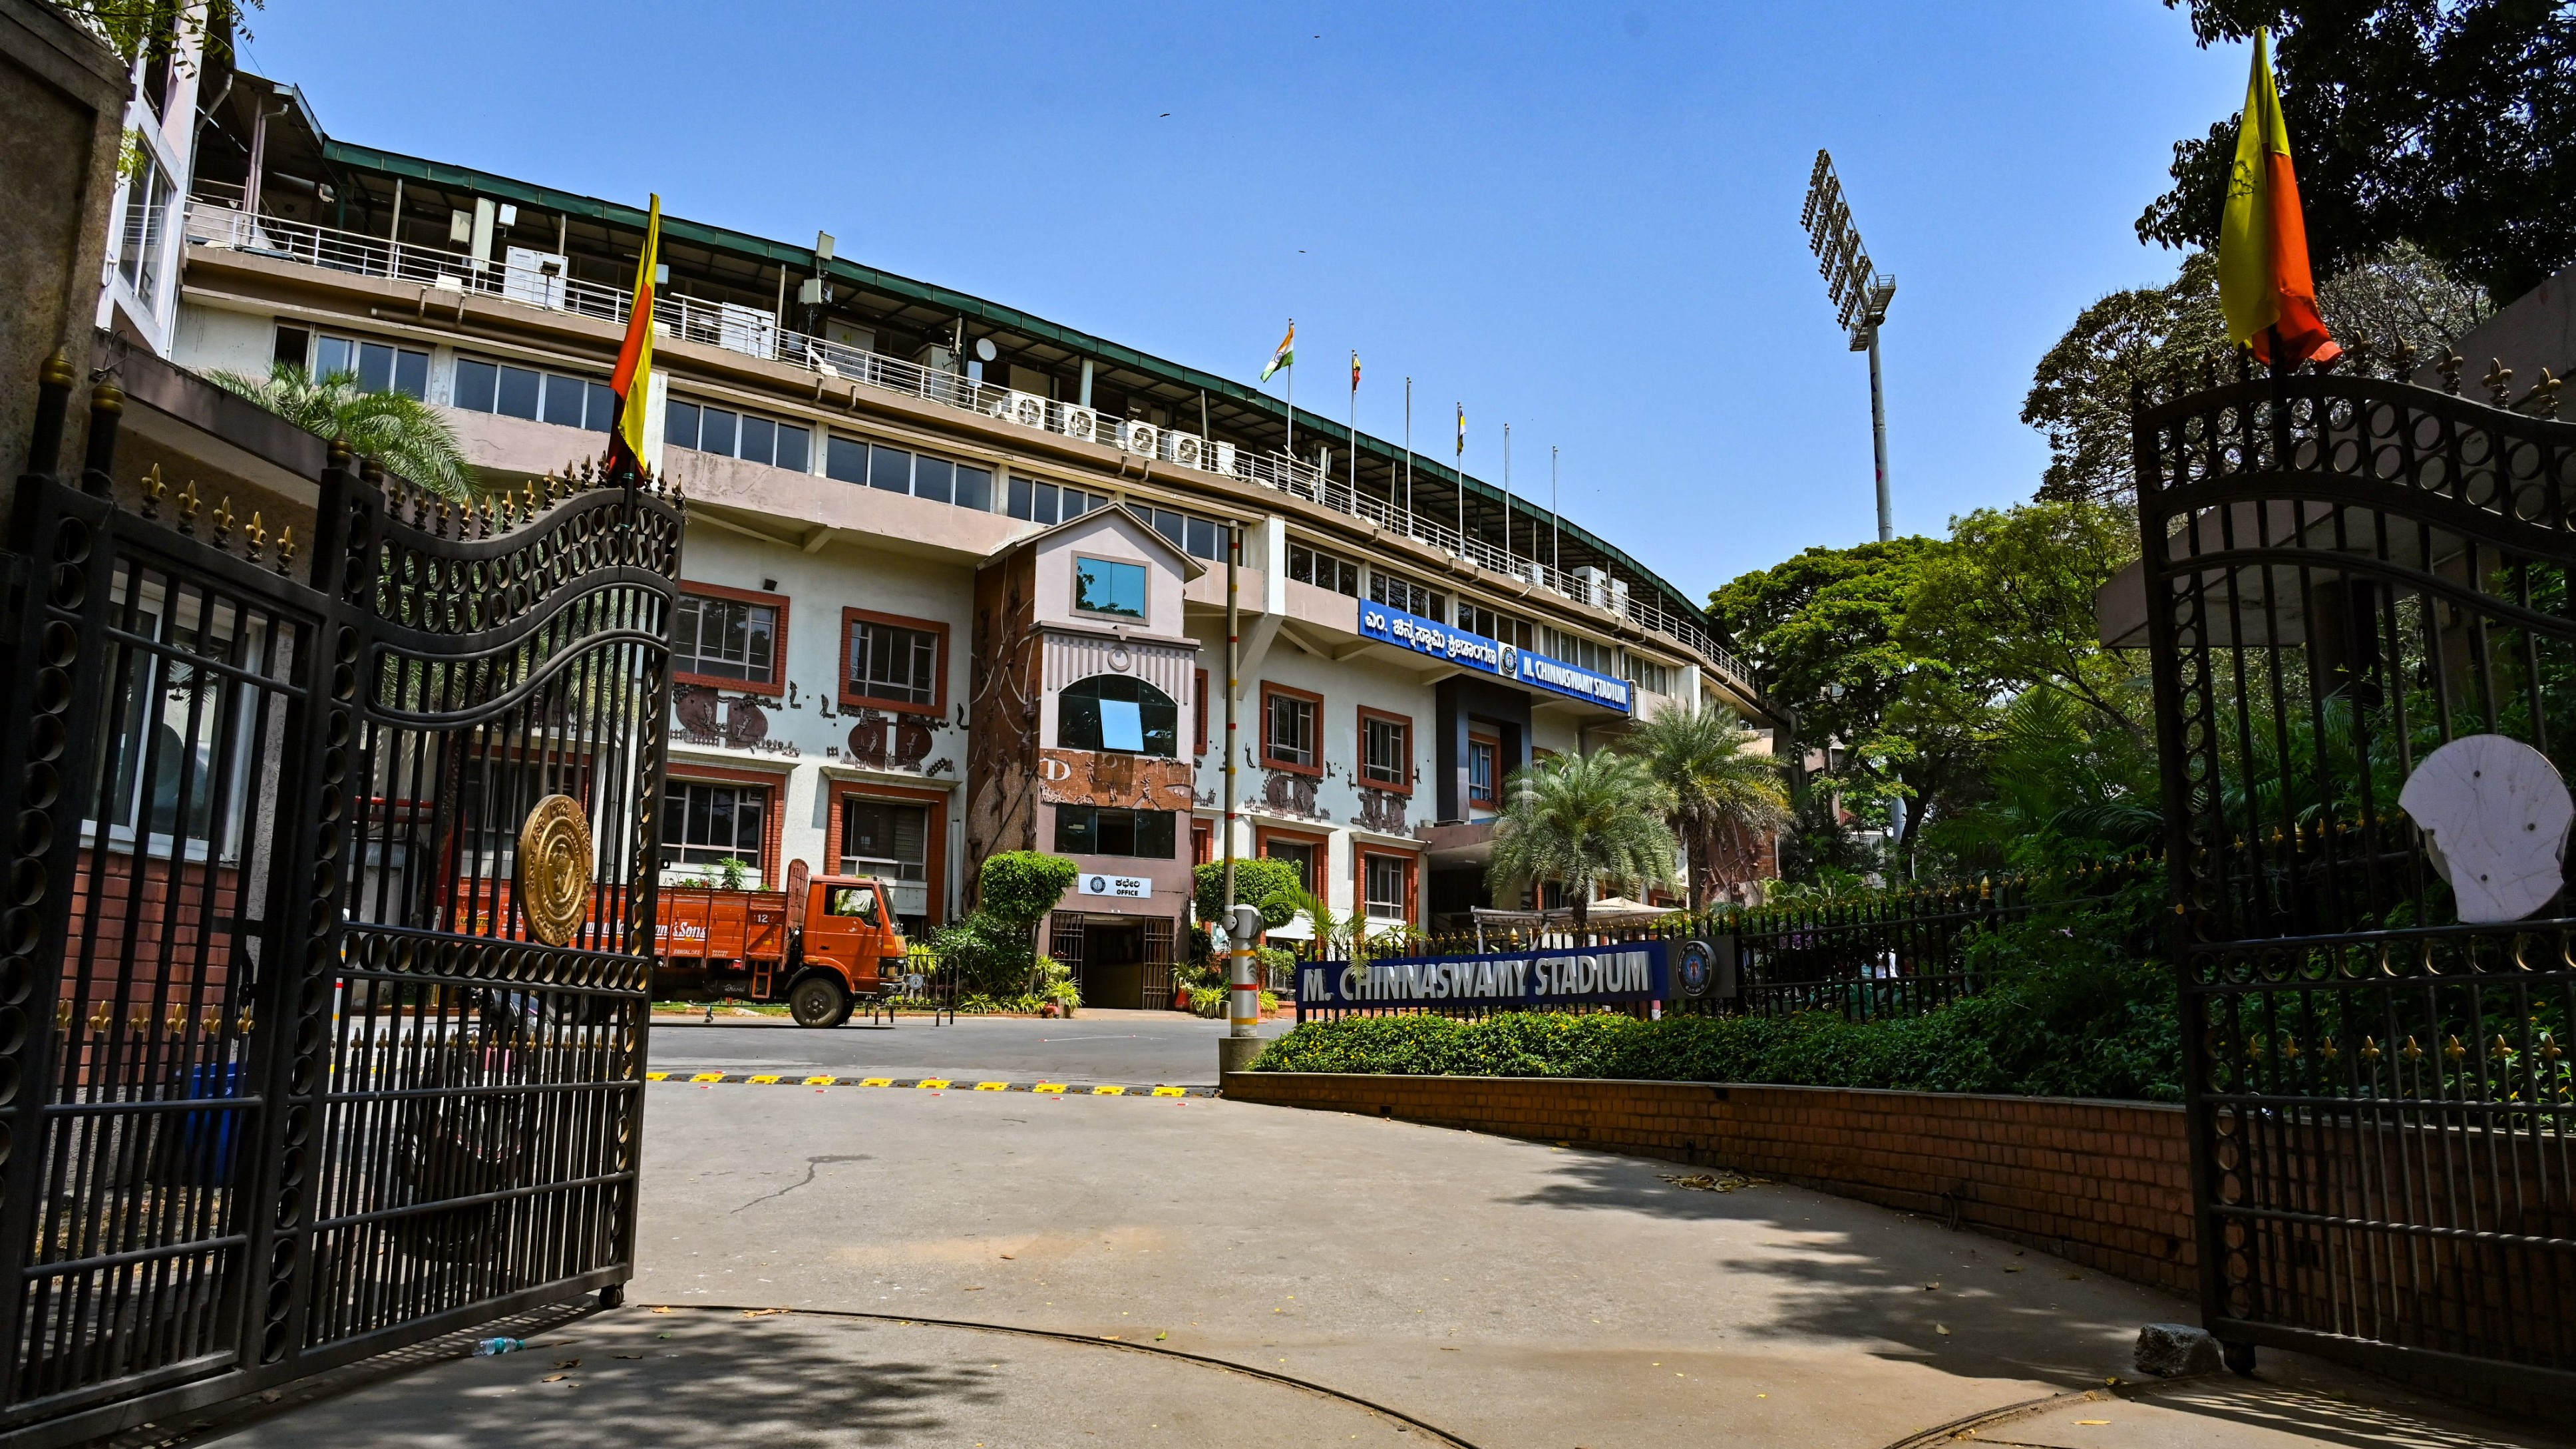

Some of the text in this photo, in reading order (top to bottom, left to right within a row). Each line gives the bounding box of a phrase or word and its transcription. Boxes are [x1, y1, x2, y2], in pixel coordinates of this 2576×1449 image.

[1365, 611, 1388, 632] ಎಂ.
[1392, 618, 1445, 652] ಚಿನ್ನಸ್ವಾಮಿ
[1523, 656, 1535, 677] M.
[1535, 660, 1594, 694] CHINNASWAMY
[1593, 678, 1626, 704] STADIUM
[757, 914, 768, 923] 12
[1302, 968, 1334, 1002] M.
[1339, 959, 1533, 1001] CHINNASWAMY
[1535, 950, 1653, 995] STADIUM
